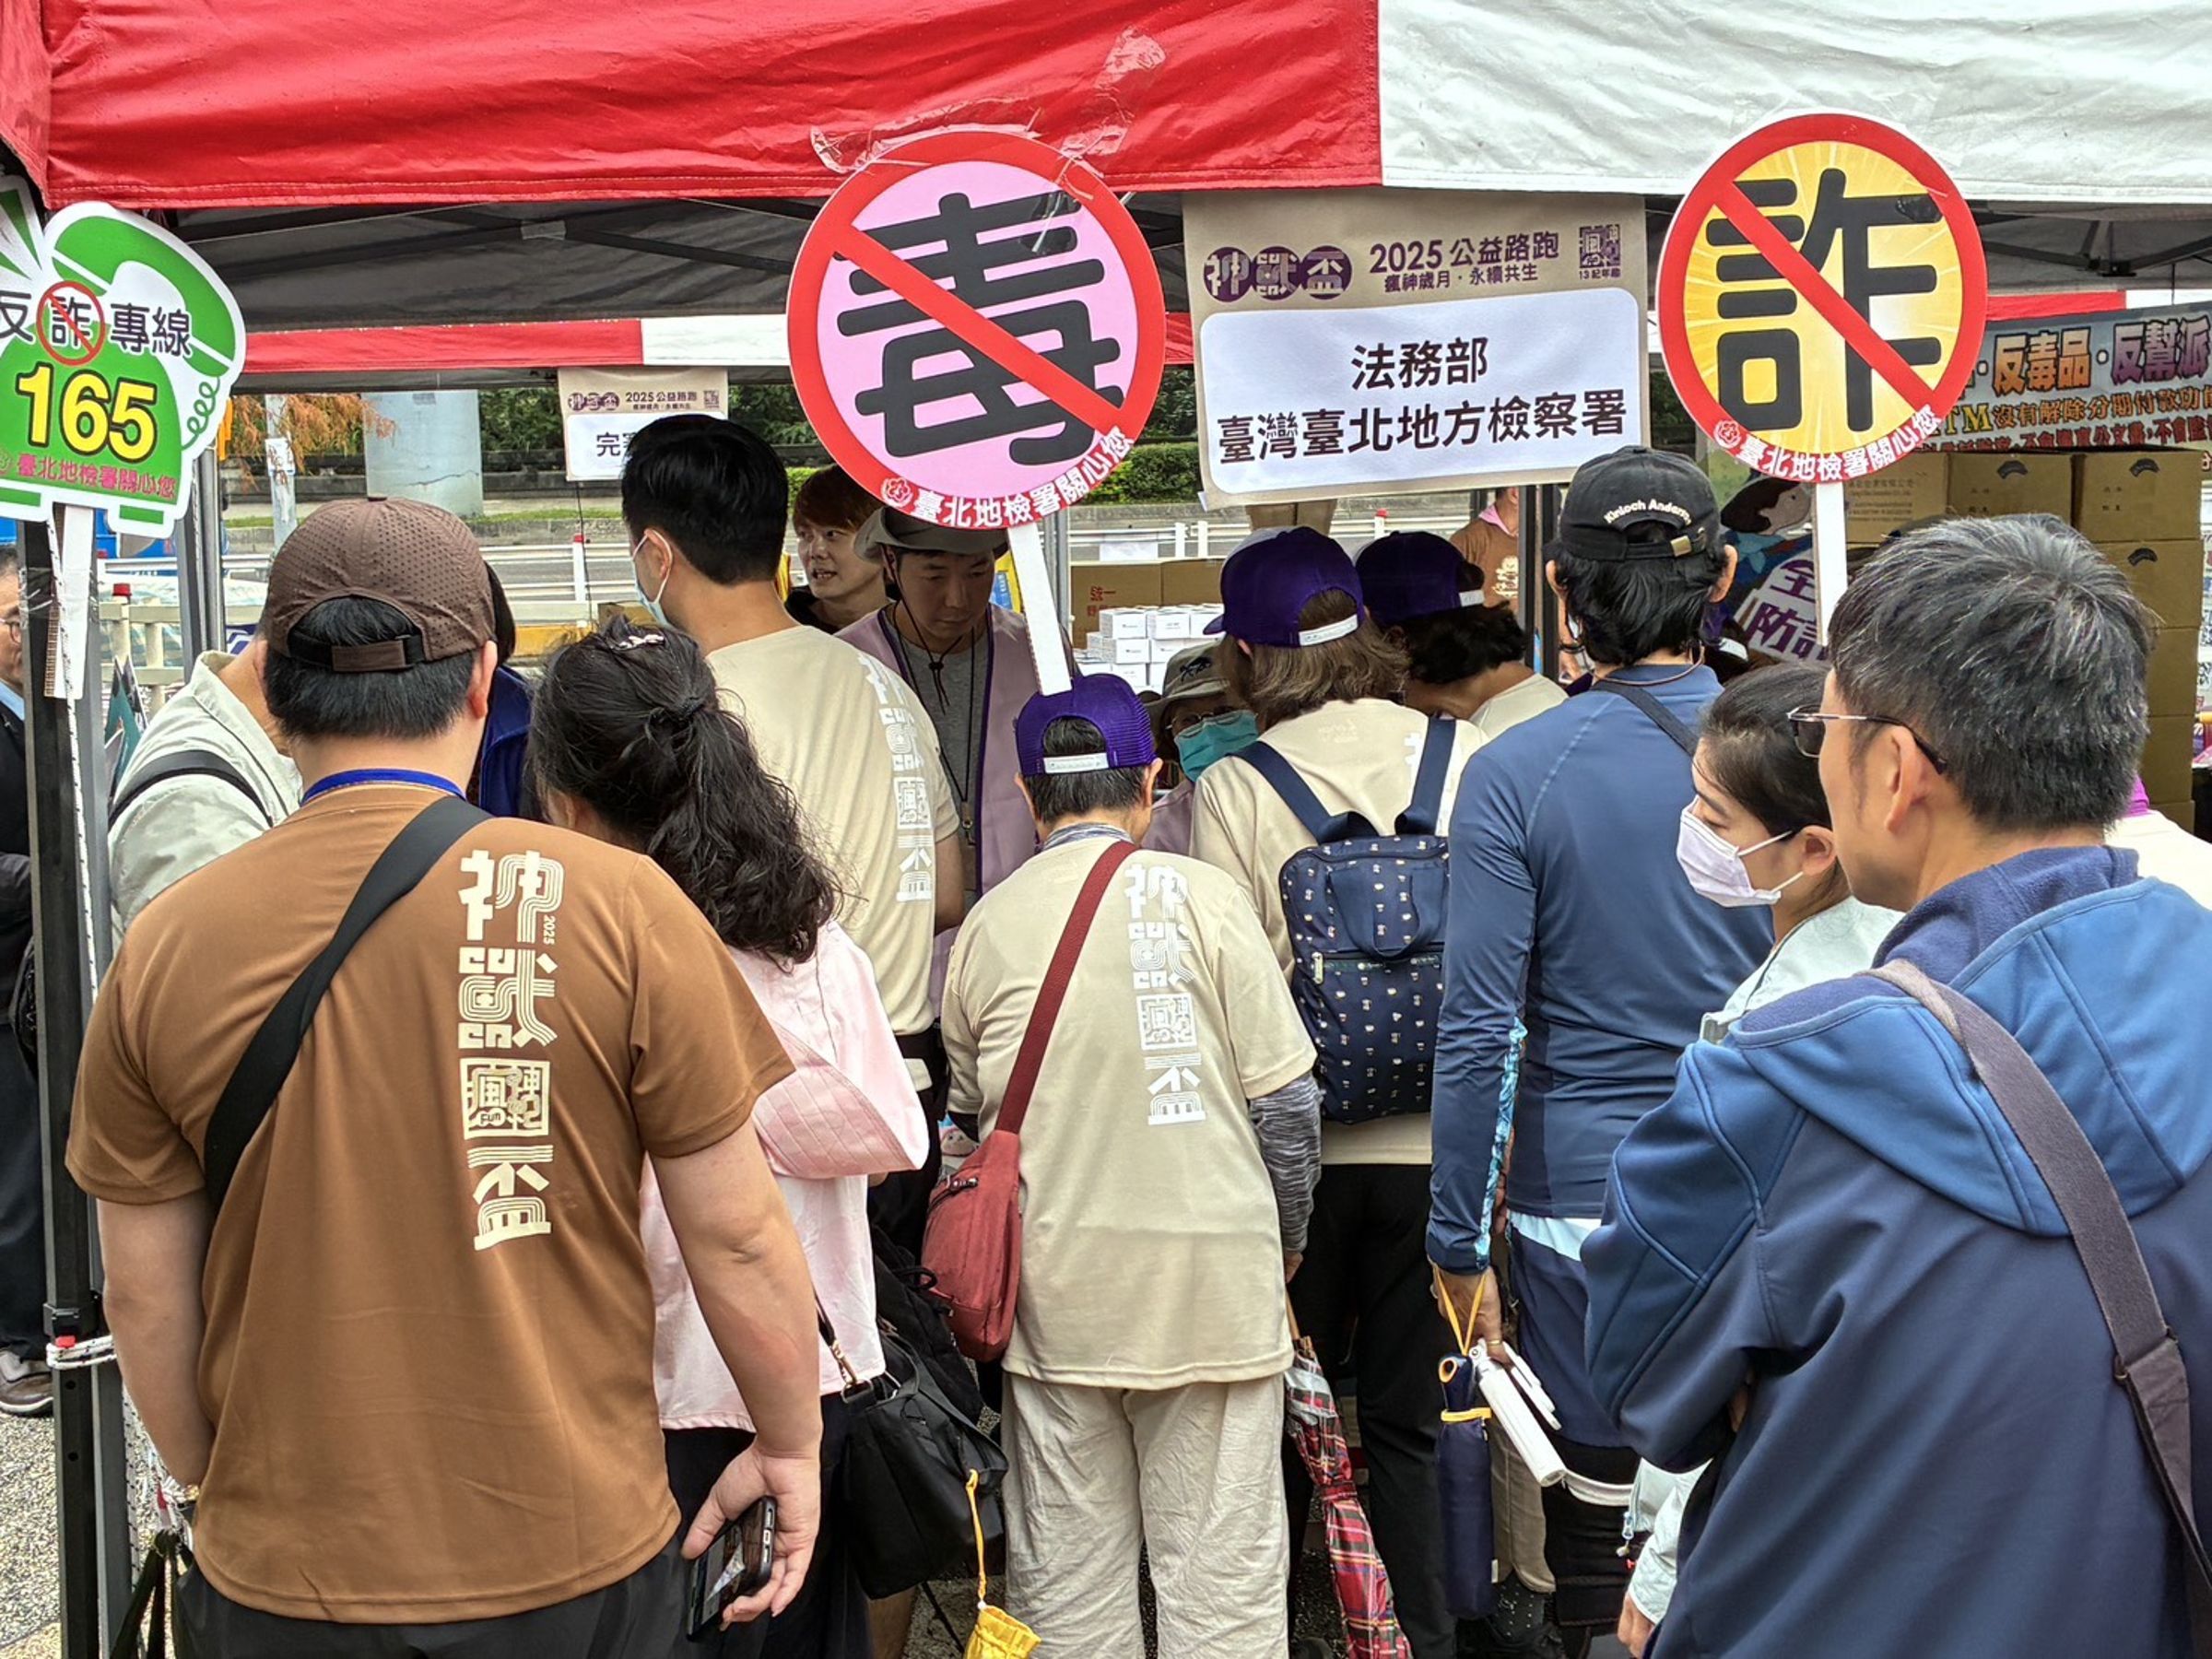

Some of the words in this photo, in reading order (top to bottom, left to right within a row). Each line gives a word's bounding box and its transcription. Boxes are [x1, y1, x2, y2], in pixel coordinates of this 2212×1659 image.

[1369, 239, 1442, 275] 2025
[1449, 230, 1560, 268] 公益路跑
[832, 192, 1124, 465] 毒
[1705, 168, 1943, 431] 詐
[625, 391, 654, 403] 2025
[1350, 336, 1489, 391] 法務部
[15, 361, 159, 464] 165
[1217, 387, 1629, 465] 臺灣臺北地方檢察署
[912, 424, 1135, 528] 臺北地檢署關心您
[542, 914, 556, 946] 2025
